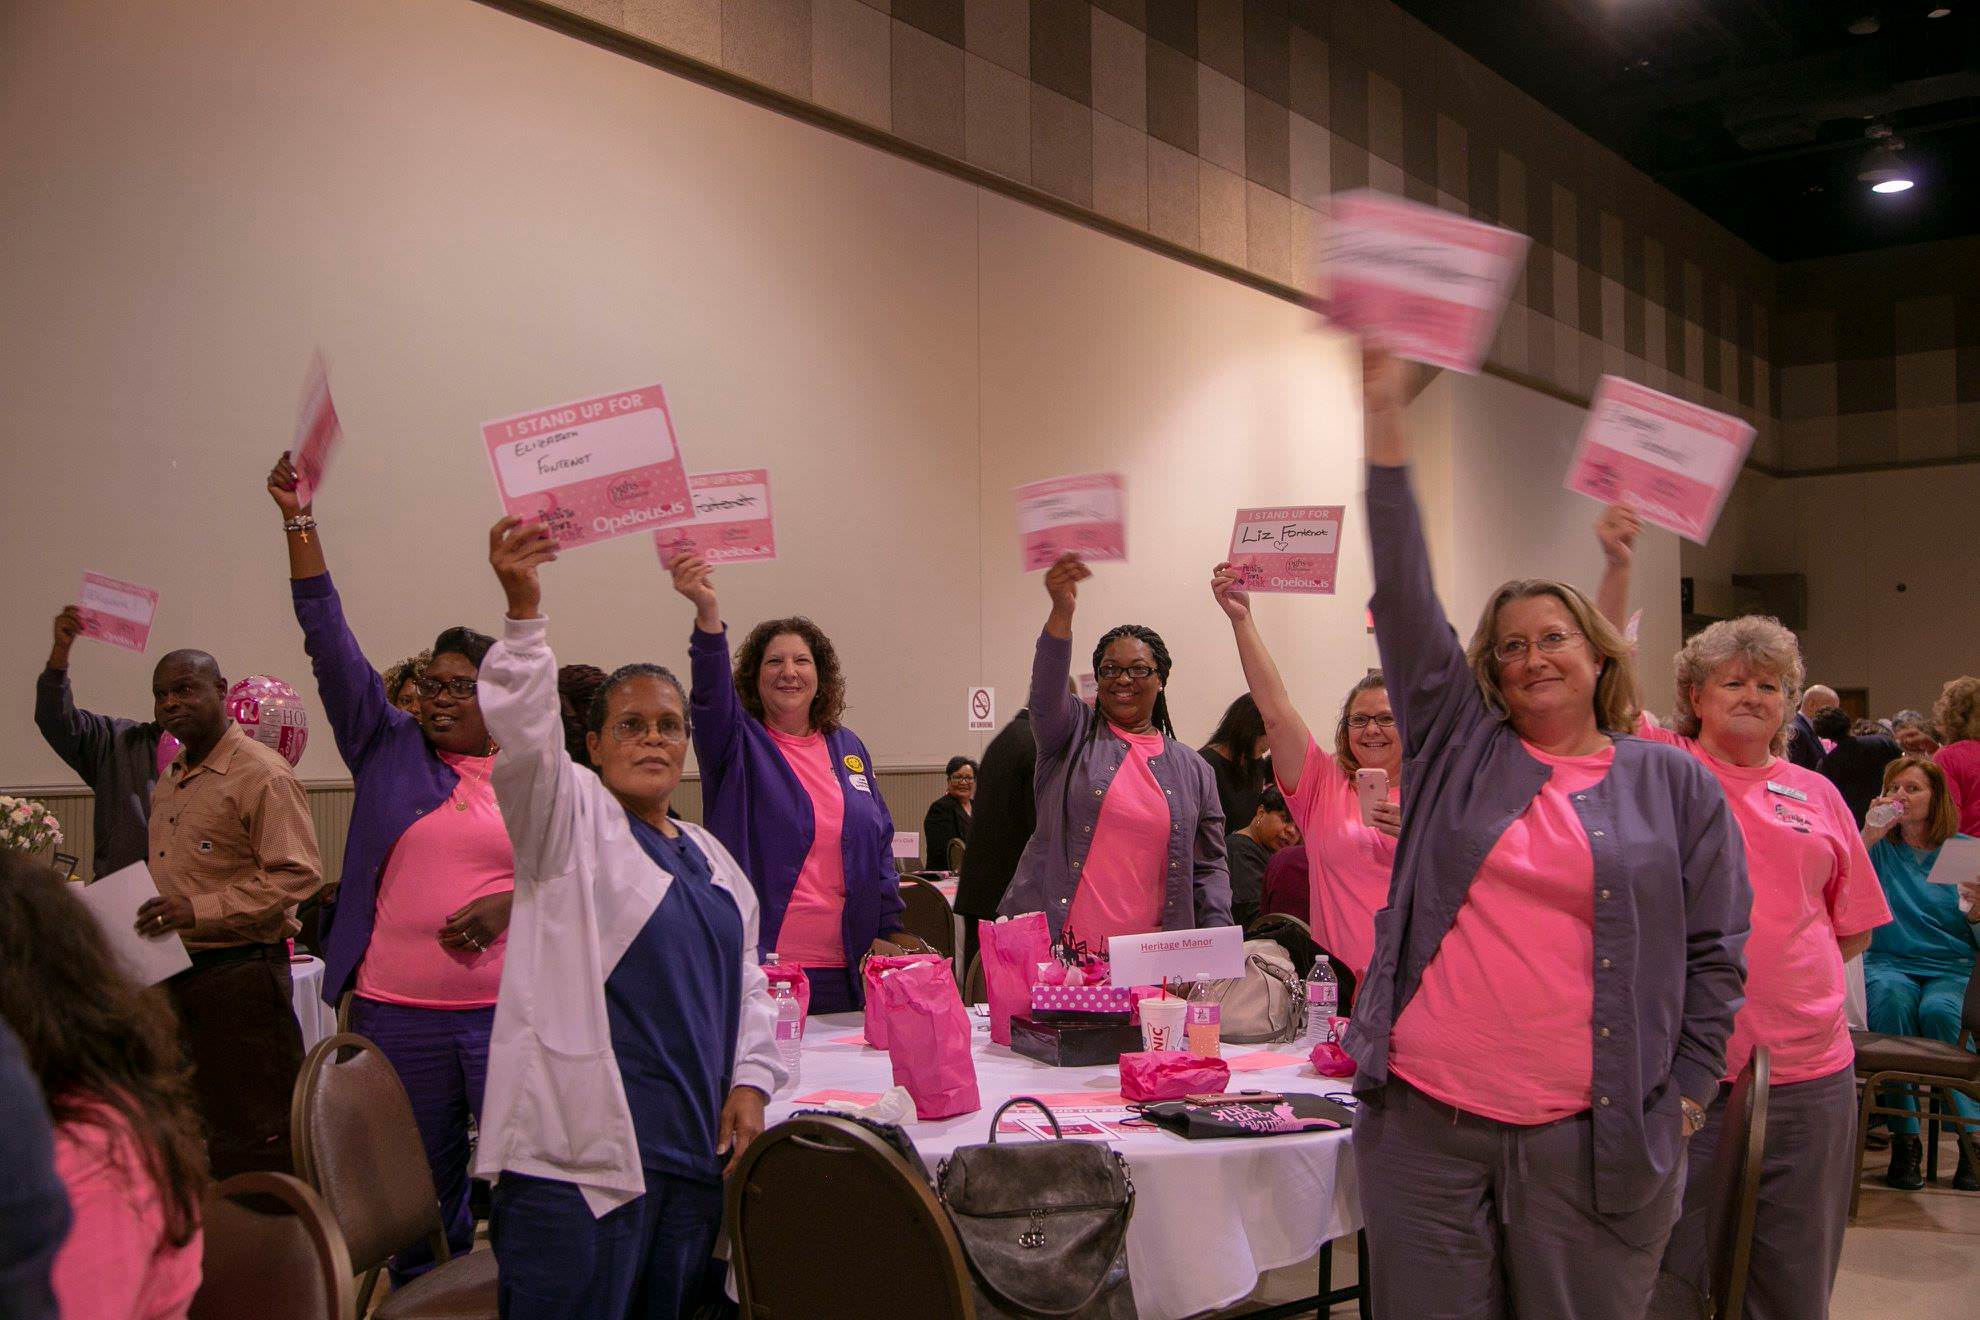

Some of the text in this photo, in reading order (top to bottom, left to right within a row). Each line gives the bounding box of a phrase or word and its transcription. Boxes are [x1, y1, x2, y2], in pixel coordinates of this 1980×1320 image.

[506, 394, 644, 438] I STAND UP FOR
[1254, 510, 1289, 520] STAND
[1291, 510, 1305, 520] UP
[1308, 510, 1329, 519] FOR
[1241, 526, 1275, 544] Liz
[1141, 938, 1213, 951] Heritage Manor
